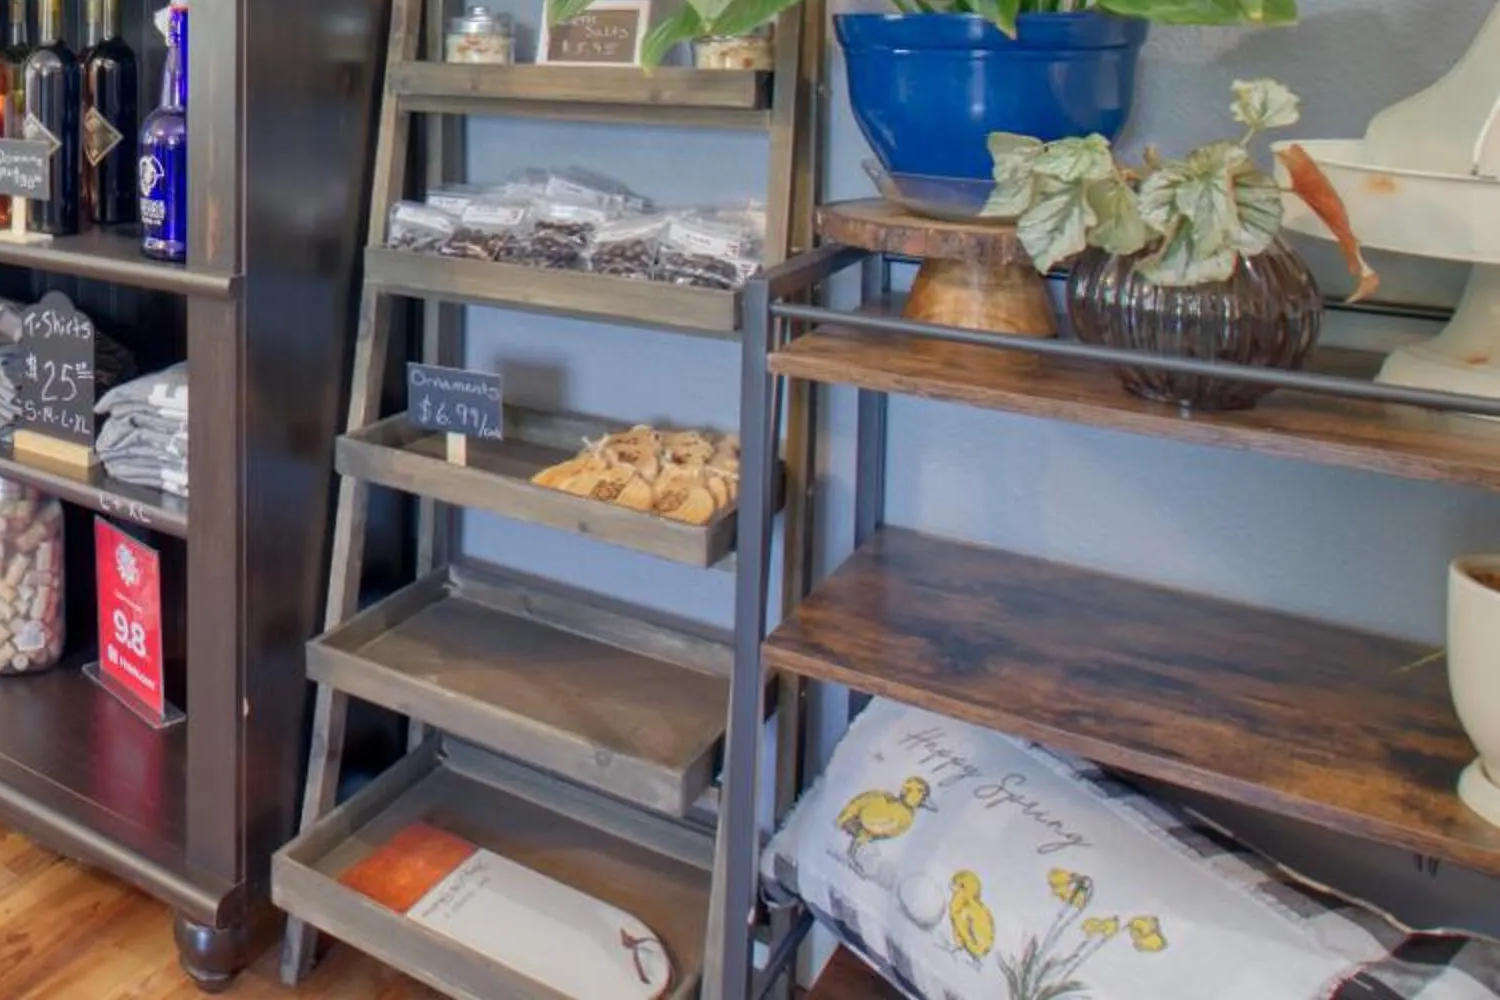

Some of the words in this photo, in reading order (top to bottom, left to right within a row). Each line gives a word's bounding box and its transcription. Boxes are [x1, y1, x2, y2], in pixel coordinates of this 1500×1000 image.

[410, 369, 500, 401] Ornaments
[897, 727, 985, 788] Happy
[973, 773, 1096, 855] Spring
